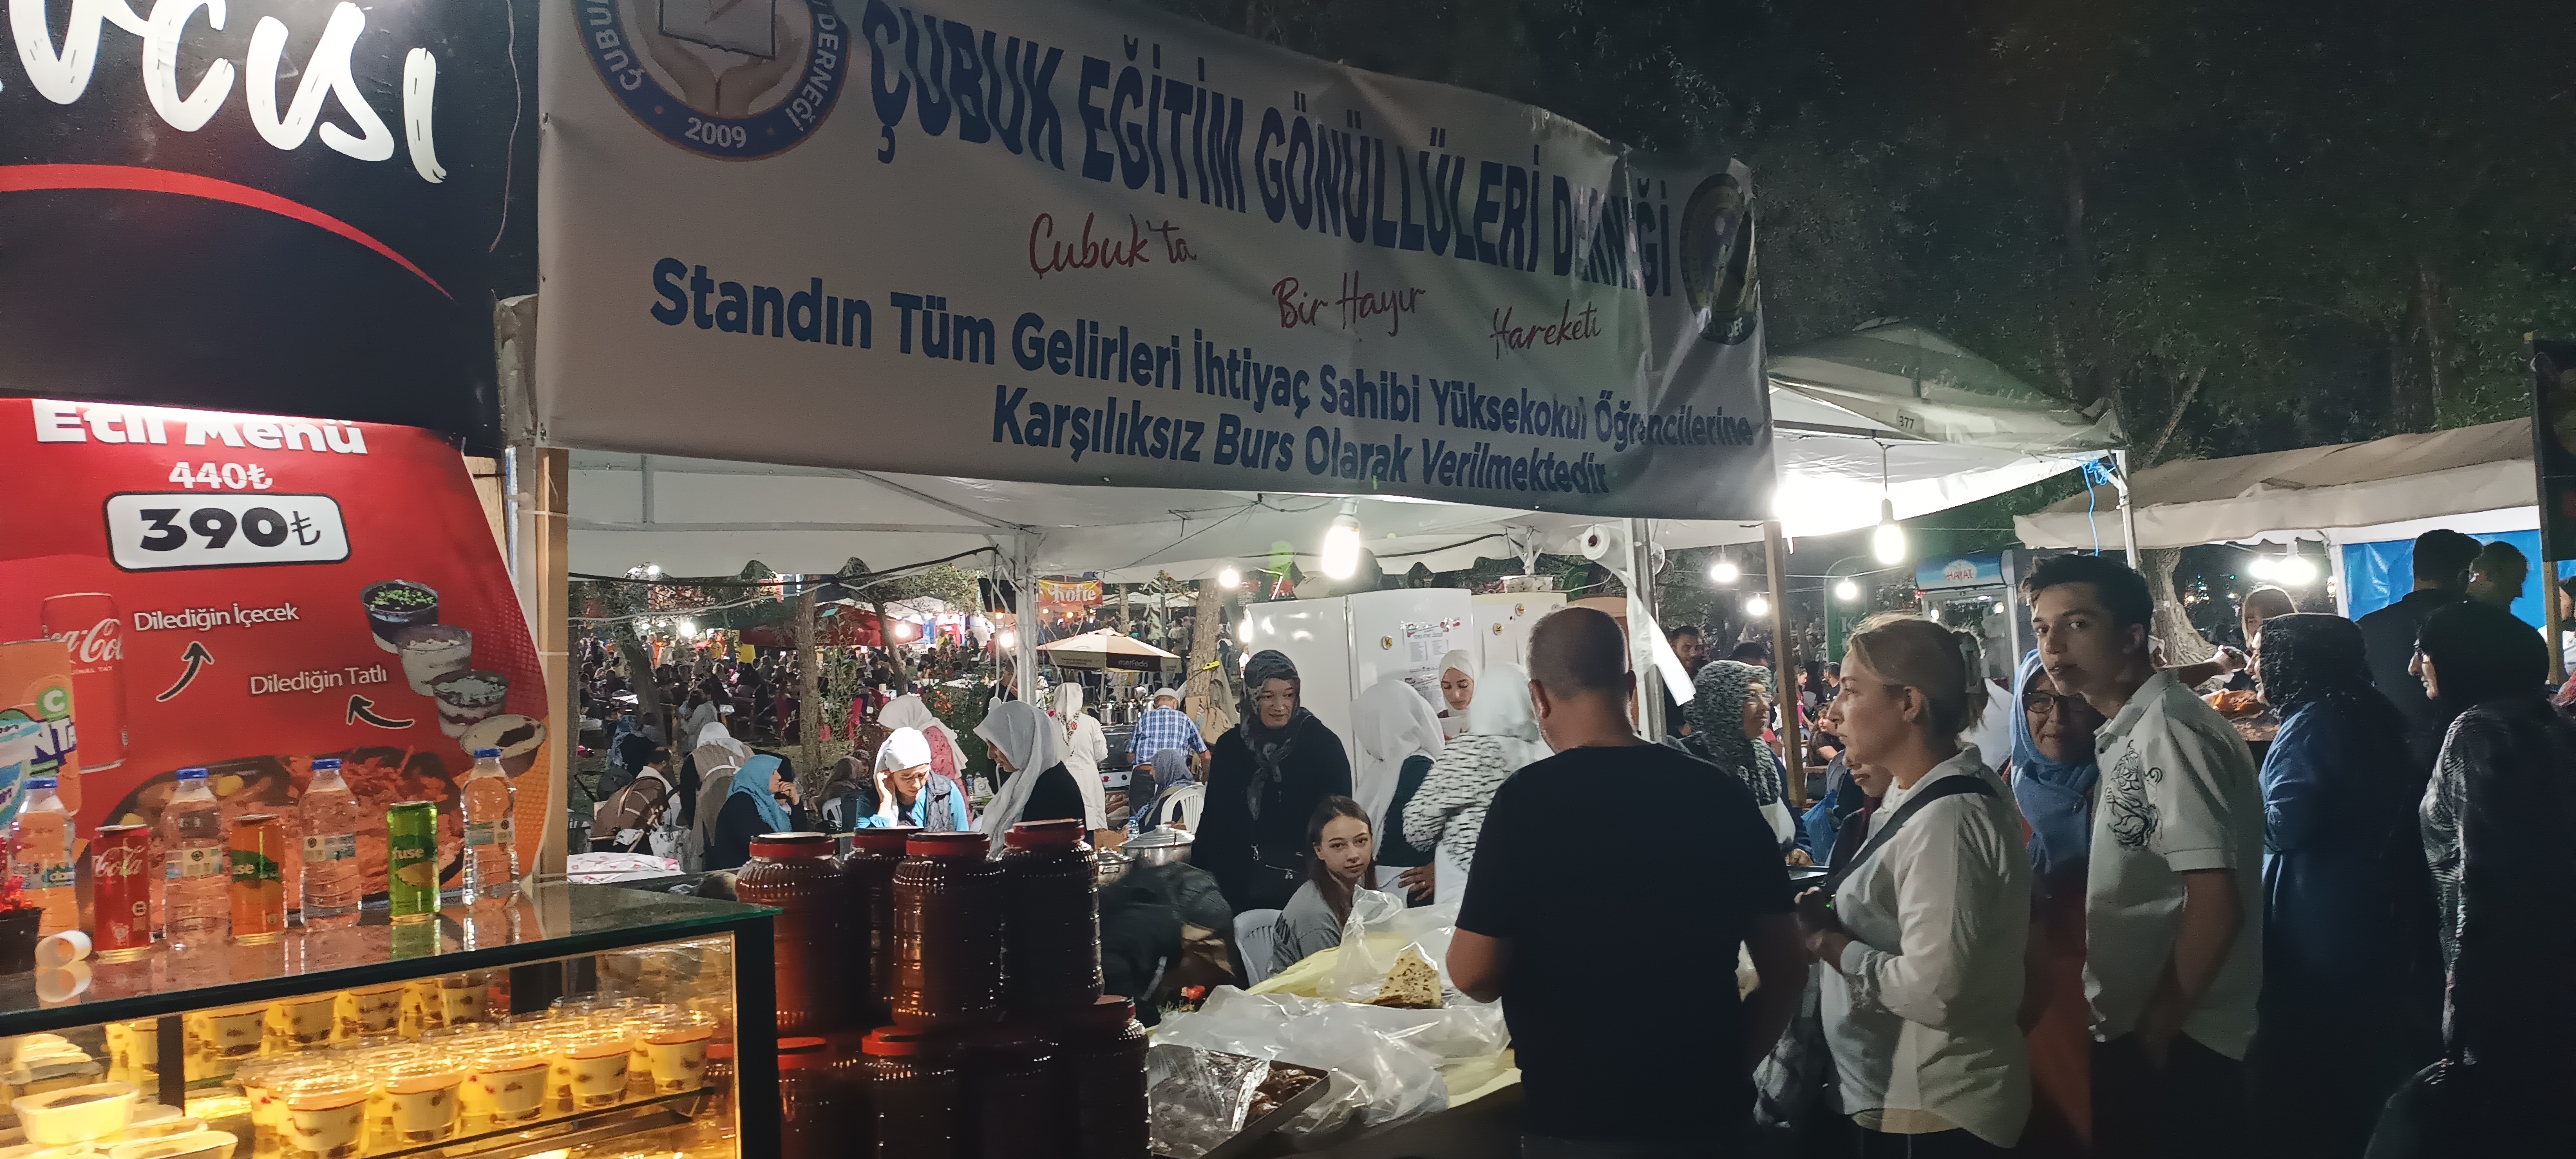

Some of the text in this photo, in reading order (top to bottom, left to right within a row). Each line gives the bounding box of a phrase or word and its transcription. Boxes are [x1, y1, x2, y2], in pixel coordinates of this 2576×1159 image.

[587, 0, 645, 91] ÇUBU
[685, 117, 746, 149] 2009
[862, 0, 1065, 171] ÇUBUK
[1078, 34, 1246, 213] EĞİTİM
[1255, 90, 1540, 273] GÖNÜLLÜLERİ
[1272, 276, 1328, 328] Bir
[1336, 270, 1426, 337] Hayır
[650, 257, 873, 350] Standın
[891, 292, 996, 366] Tüm
[1012, 312, 1181, 391] Gelirleri
[1194, 328, 1310, 419] İhtiyaç
[1320, 364, 1420, 424] Sahibi
[1429, 377, 1587, 440] Yüksekokul
[184, 412, 368, 455] Menü
[992, 384, 1609, 495] Karşılıksız Burs Olarak Verilmektedir
[1899, 415, 1915, 429] 377
[140, 507, 321, 551] 390₺
[134, 601, 299, 632] Dilediğin İçecek
[250, 666, 388, 695] Dilediğin Tatlı
[392, 847, 424, 860] fuse
